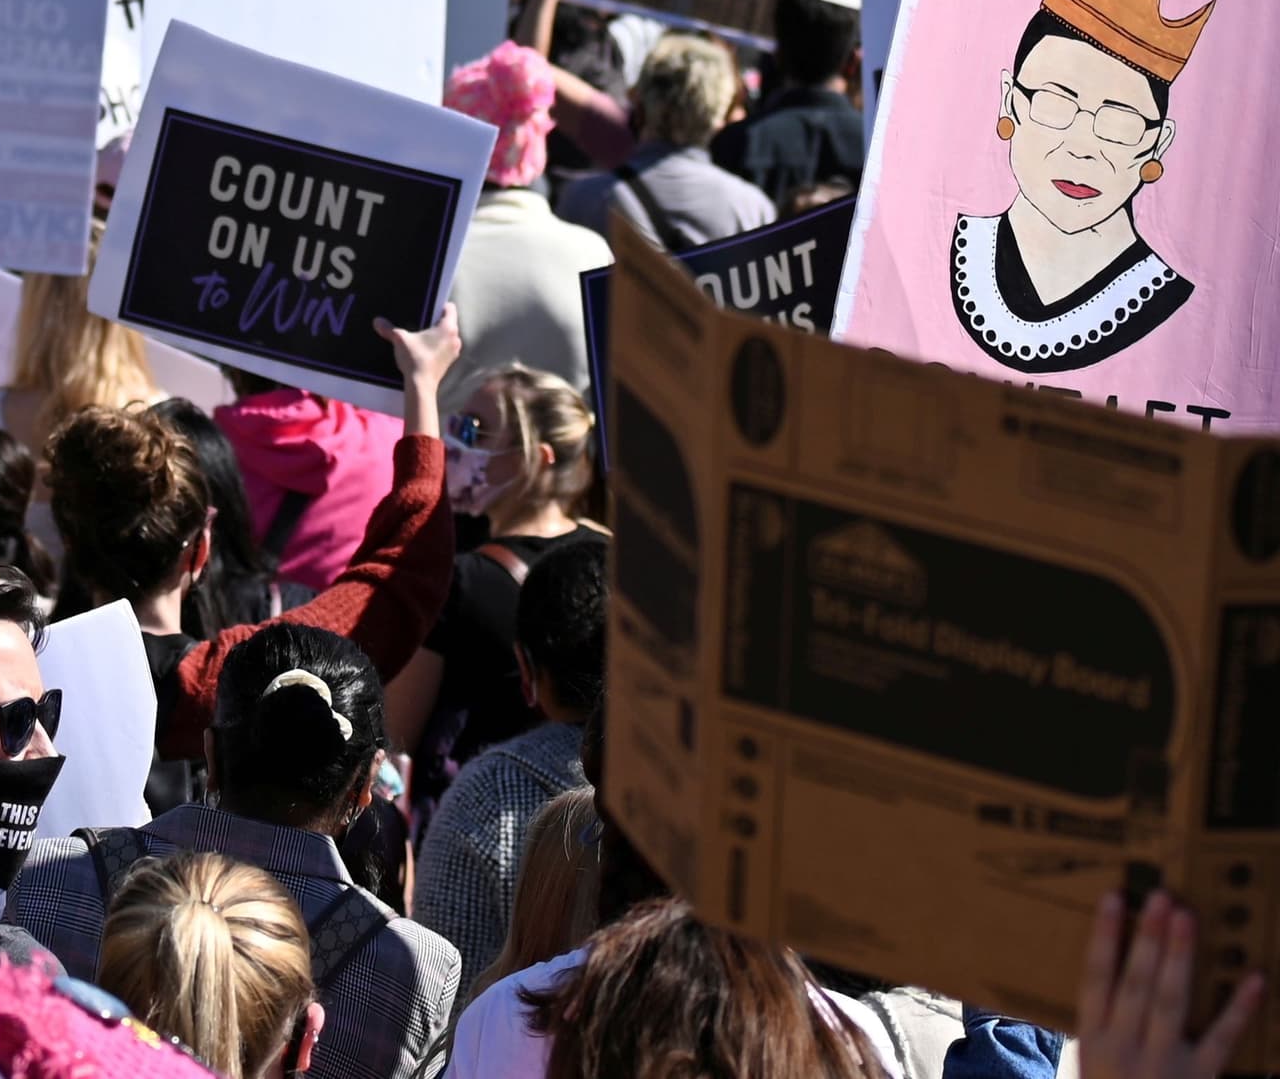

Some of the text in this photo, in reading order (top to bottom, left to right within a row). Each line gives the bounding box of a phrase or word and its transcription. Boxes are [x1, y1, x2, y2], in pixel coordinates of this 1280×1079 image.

[208, 154, 385, 238] COUNT
[207, 215, 358, 290] ON US
[192, 270, 231, 313] to
[933, 619, 1051, 688] Display
[1051, 650, 1153, 711] Board
[0, 802, 39, 826] THIS
